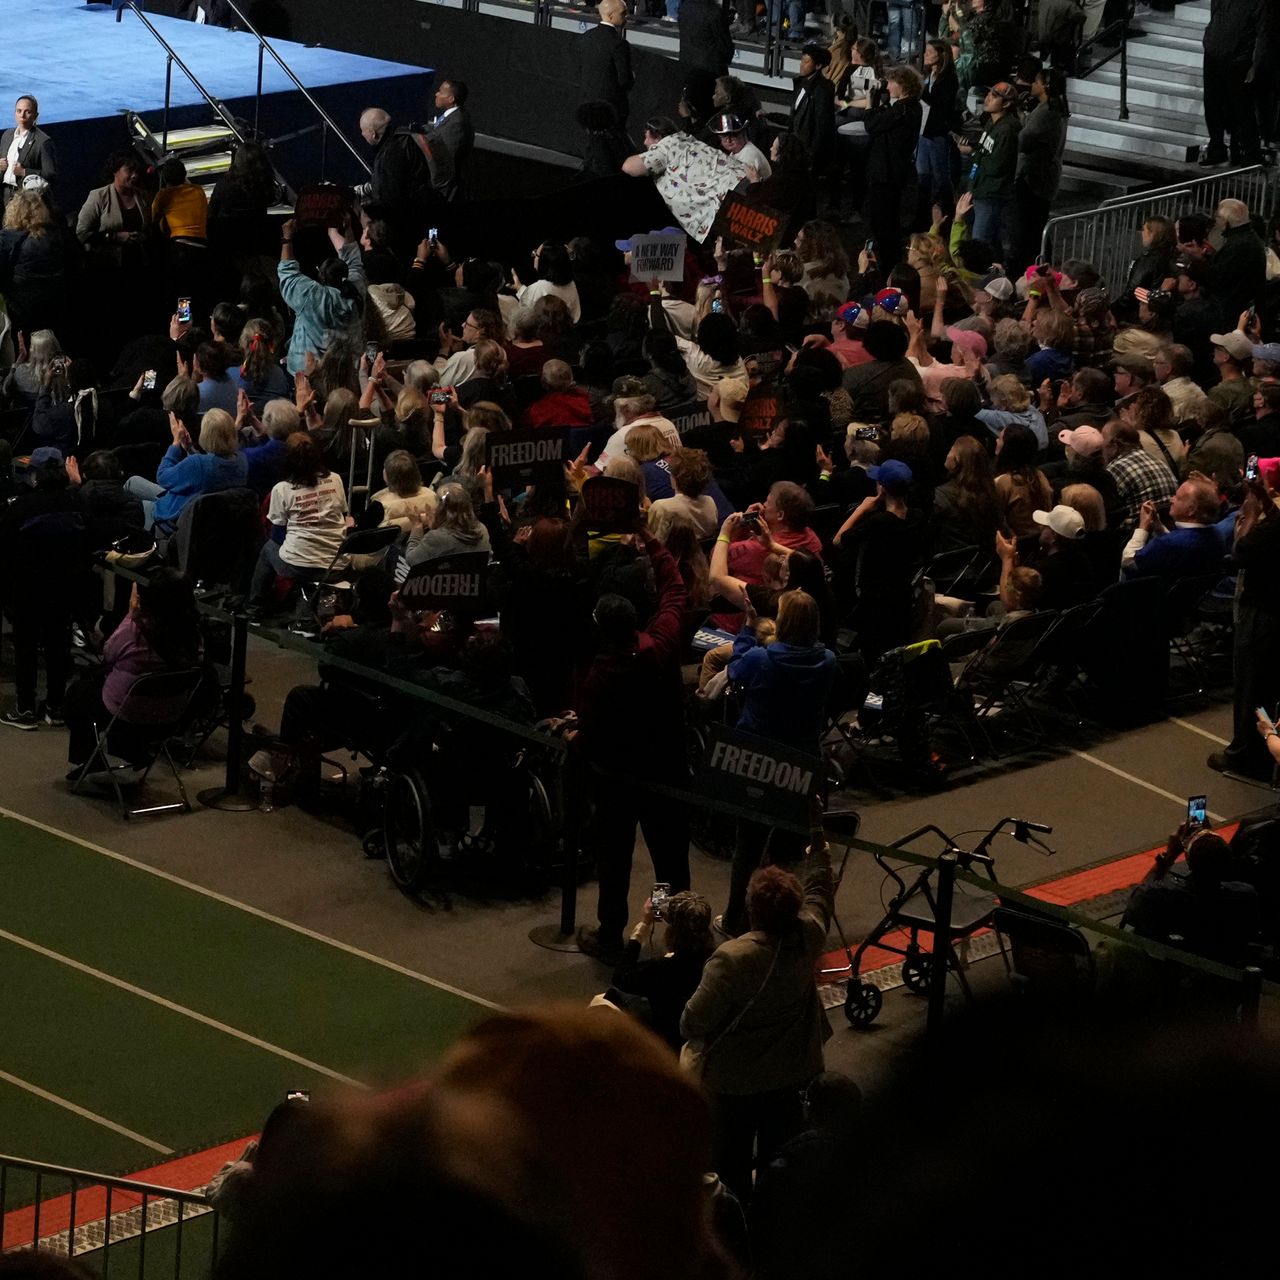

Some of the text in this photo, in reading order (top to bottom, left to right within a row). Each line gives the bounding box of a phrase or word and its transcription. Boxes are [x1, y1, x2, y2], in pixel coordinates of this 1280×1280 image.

[727, 202, 779, 234] HARRIS
[729, 222, 764, 242] WALZ
[644, 242, 680, 258] NEW WAY
[637, 257, 675, 272] FORWARD
[491, 438, 563, 466] FREEDOM
[402, 573, 480, 596] FREEDOM
[710, 741, 814, 796] FREEDOM
